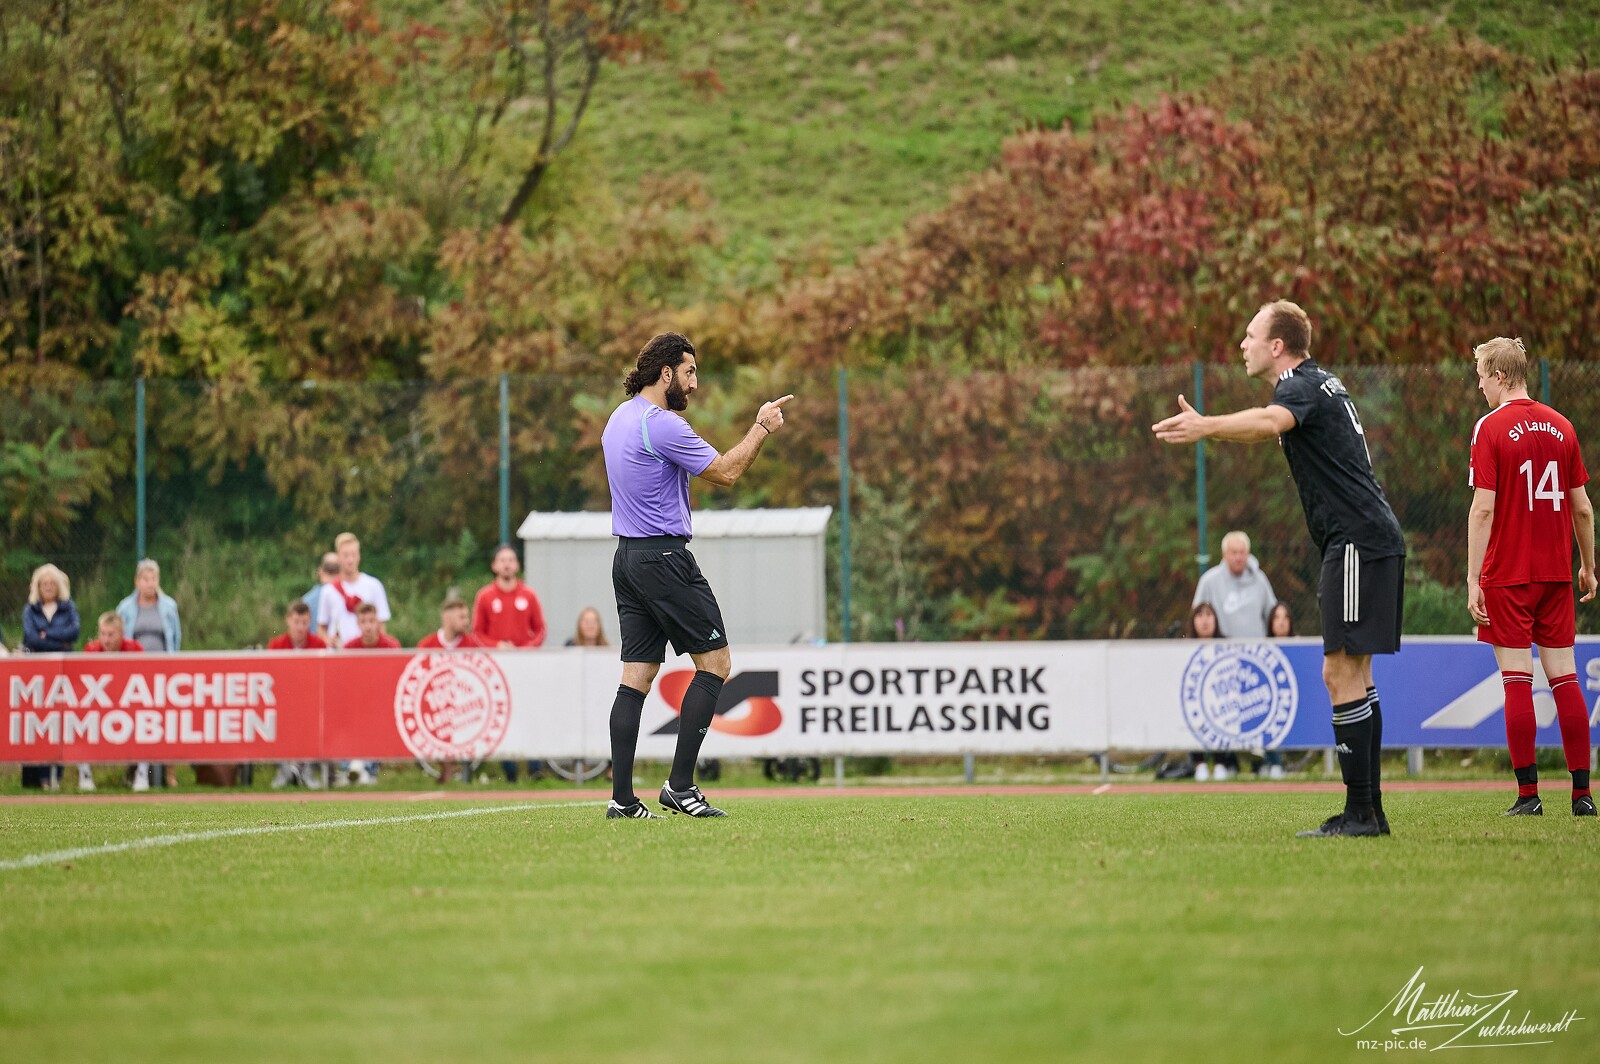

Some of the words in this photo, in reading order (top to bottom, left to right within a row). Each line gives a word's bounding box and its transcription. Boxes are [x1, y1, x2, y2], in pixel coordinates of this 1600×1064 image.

[1508, 422, 1525, 442] SV
[1524, 419, 1564, 442] Laufen
[1519, 459, 1565, 512] 14
[9, 673, 114, 709] MAX
[119, 672, 277, 708] AICHER
[800, 666, 1047, 697] SPORTPARK
[9, 708, 278, 745] IMMOBILIEN
[800, 703, 1051, 734] FREILASSING
